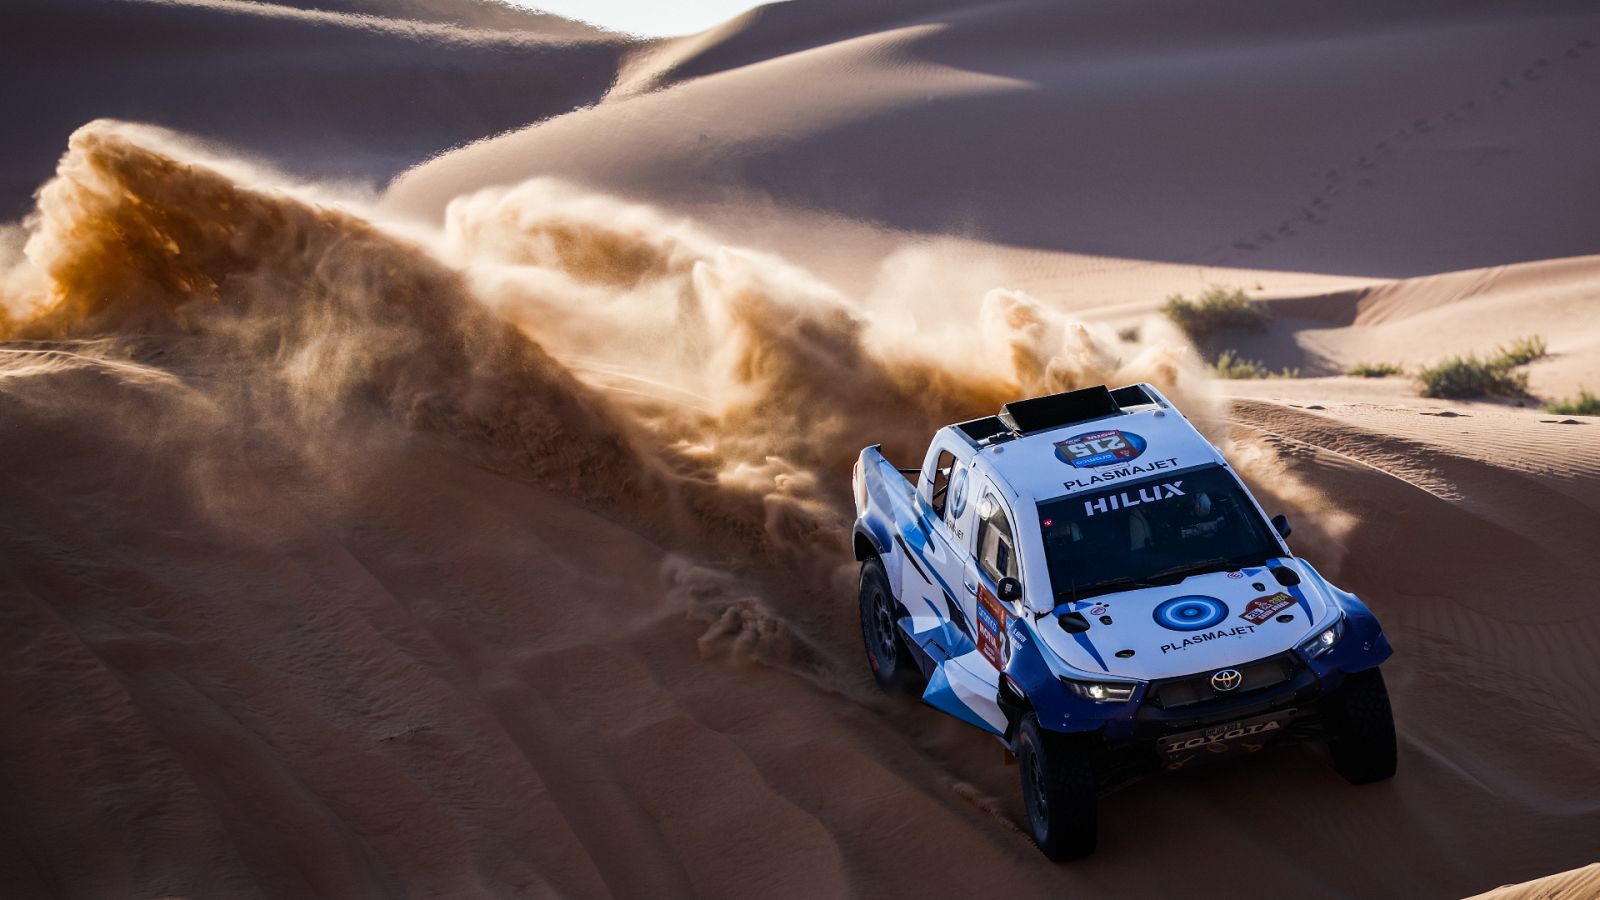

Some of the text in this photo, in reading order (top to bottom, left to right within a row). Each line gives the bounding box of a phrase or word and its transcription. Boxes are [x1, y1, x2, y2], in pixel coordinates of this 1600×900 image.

[1067, 435, 1126, 458] 215
[1075, 454, 1112, 465] aramco
[1063, 458, 1179, 491] PLASMAJET
[1084, 481, 1186, 517] HILUX
[977, 605, 997, 633] aramco
[979, 622, 998, 650] MOTUL
[1160, 625, 1255, 654] PLASMAJET
[1166, 720, 1281, 753] TOYOTA
